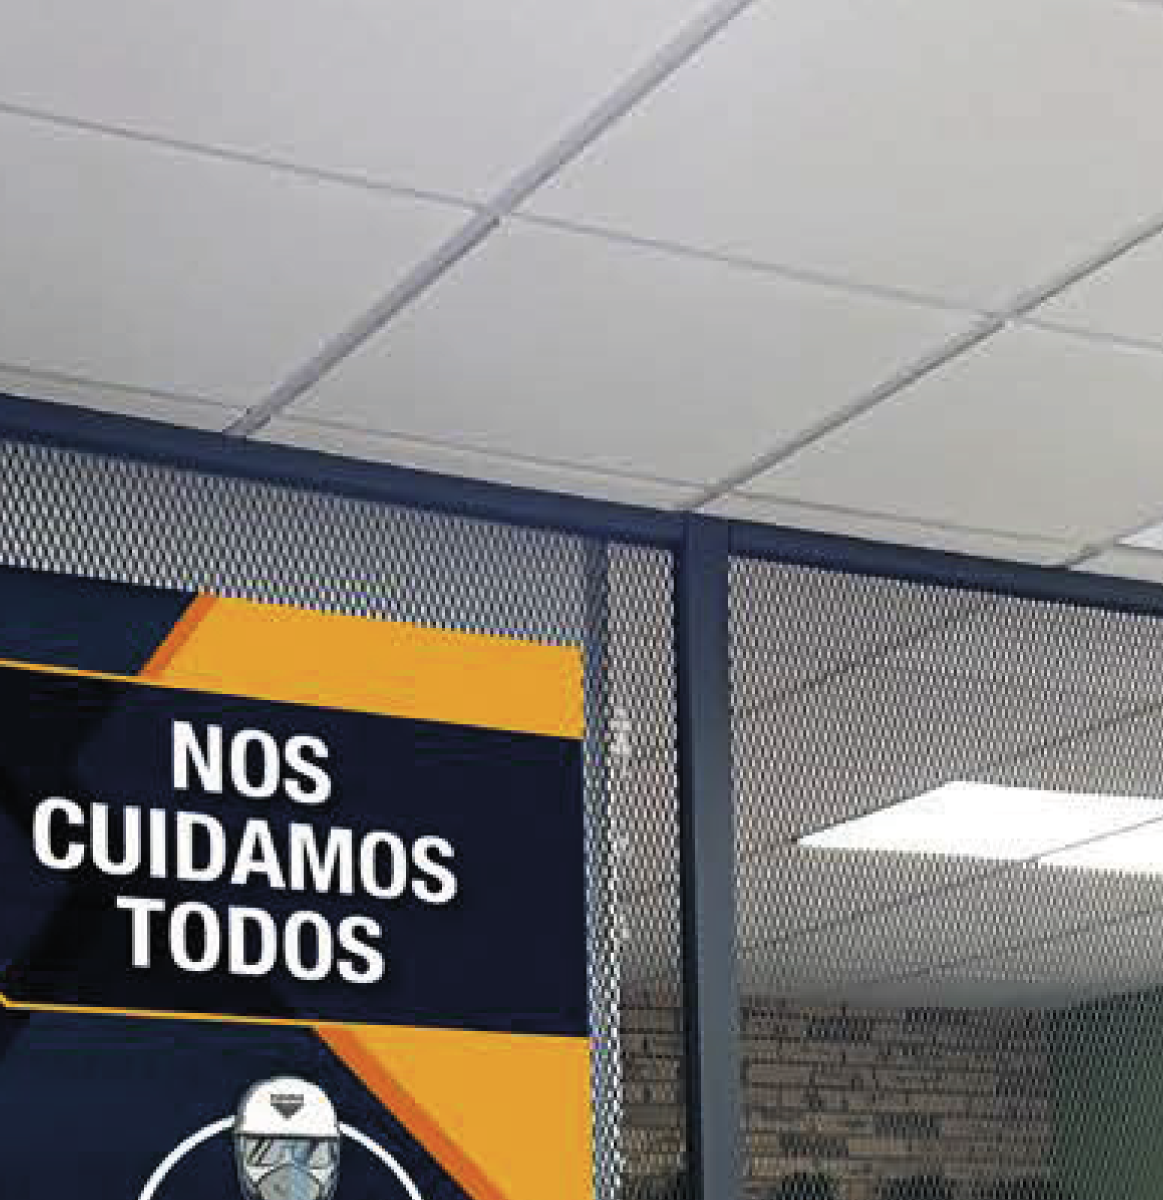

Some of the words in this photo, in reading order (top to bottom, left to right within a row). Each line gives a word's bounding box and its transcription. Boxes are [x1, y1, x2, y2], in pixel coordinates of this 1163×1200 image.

[171, 719, 332, 805] NOS
[32, 796, 458, 905] CUIDAMOS
[116, 894, 386, 984] TODOS
